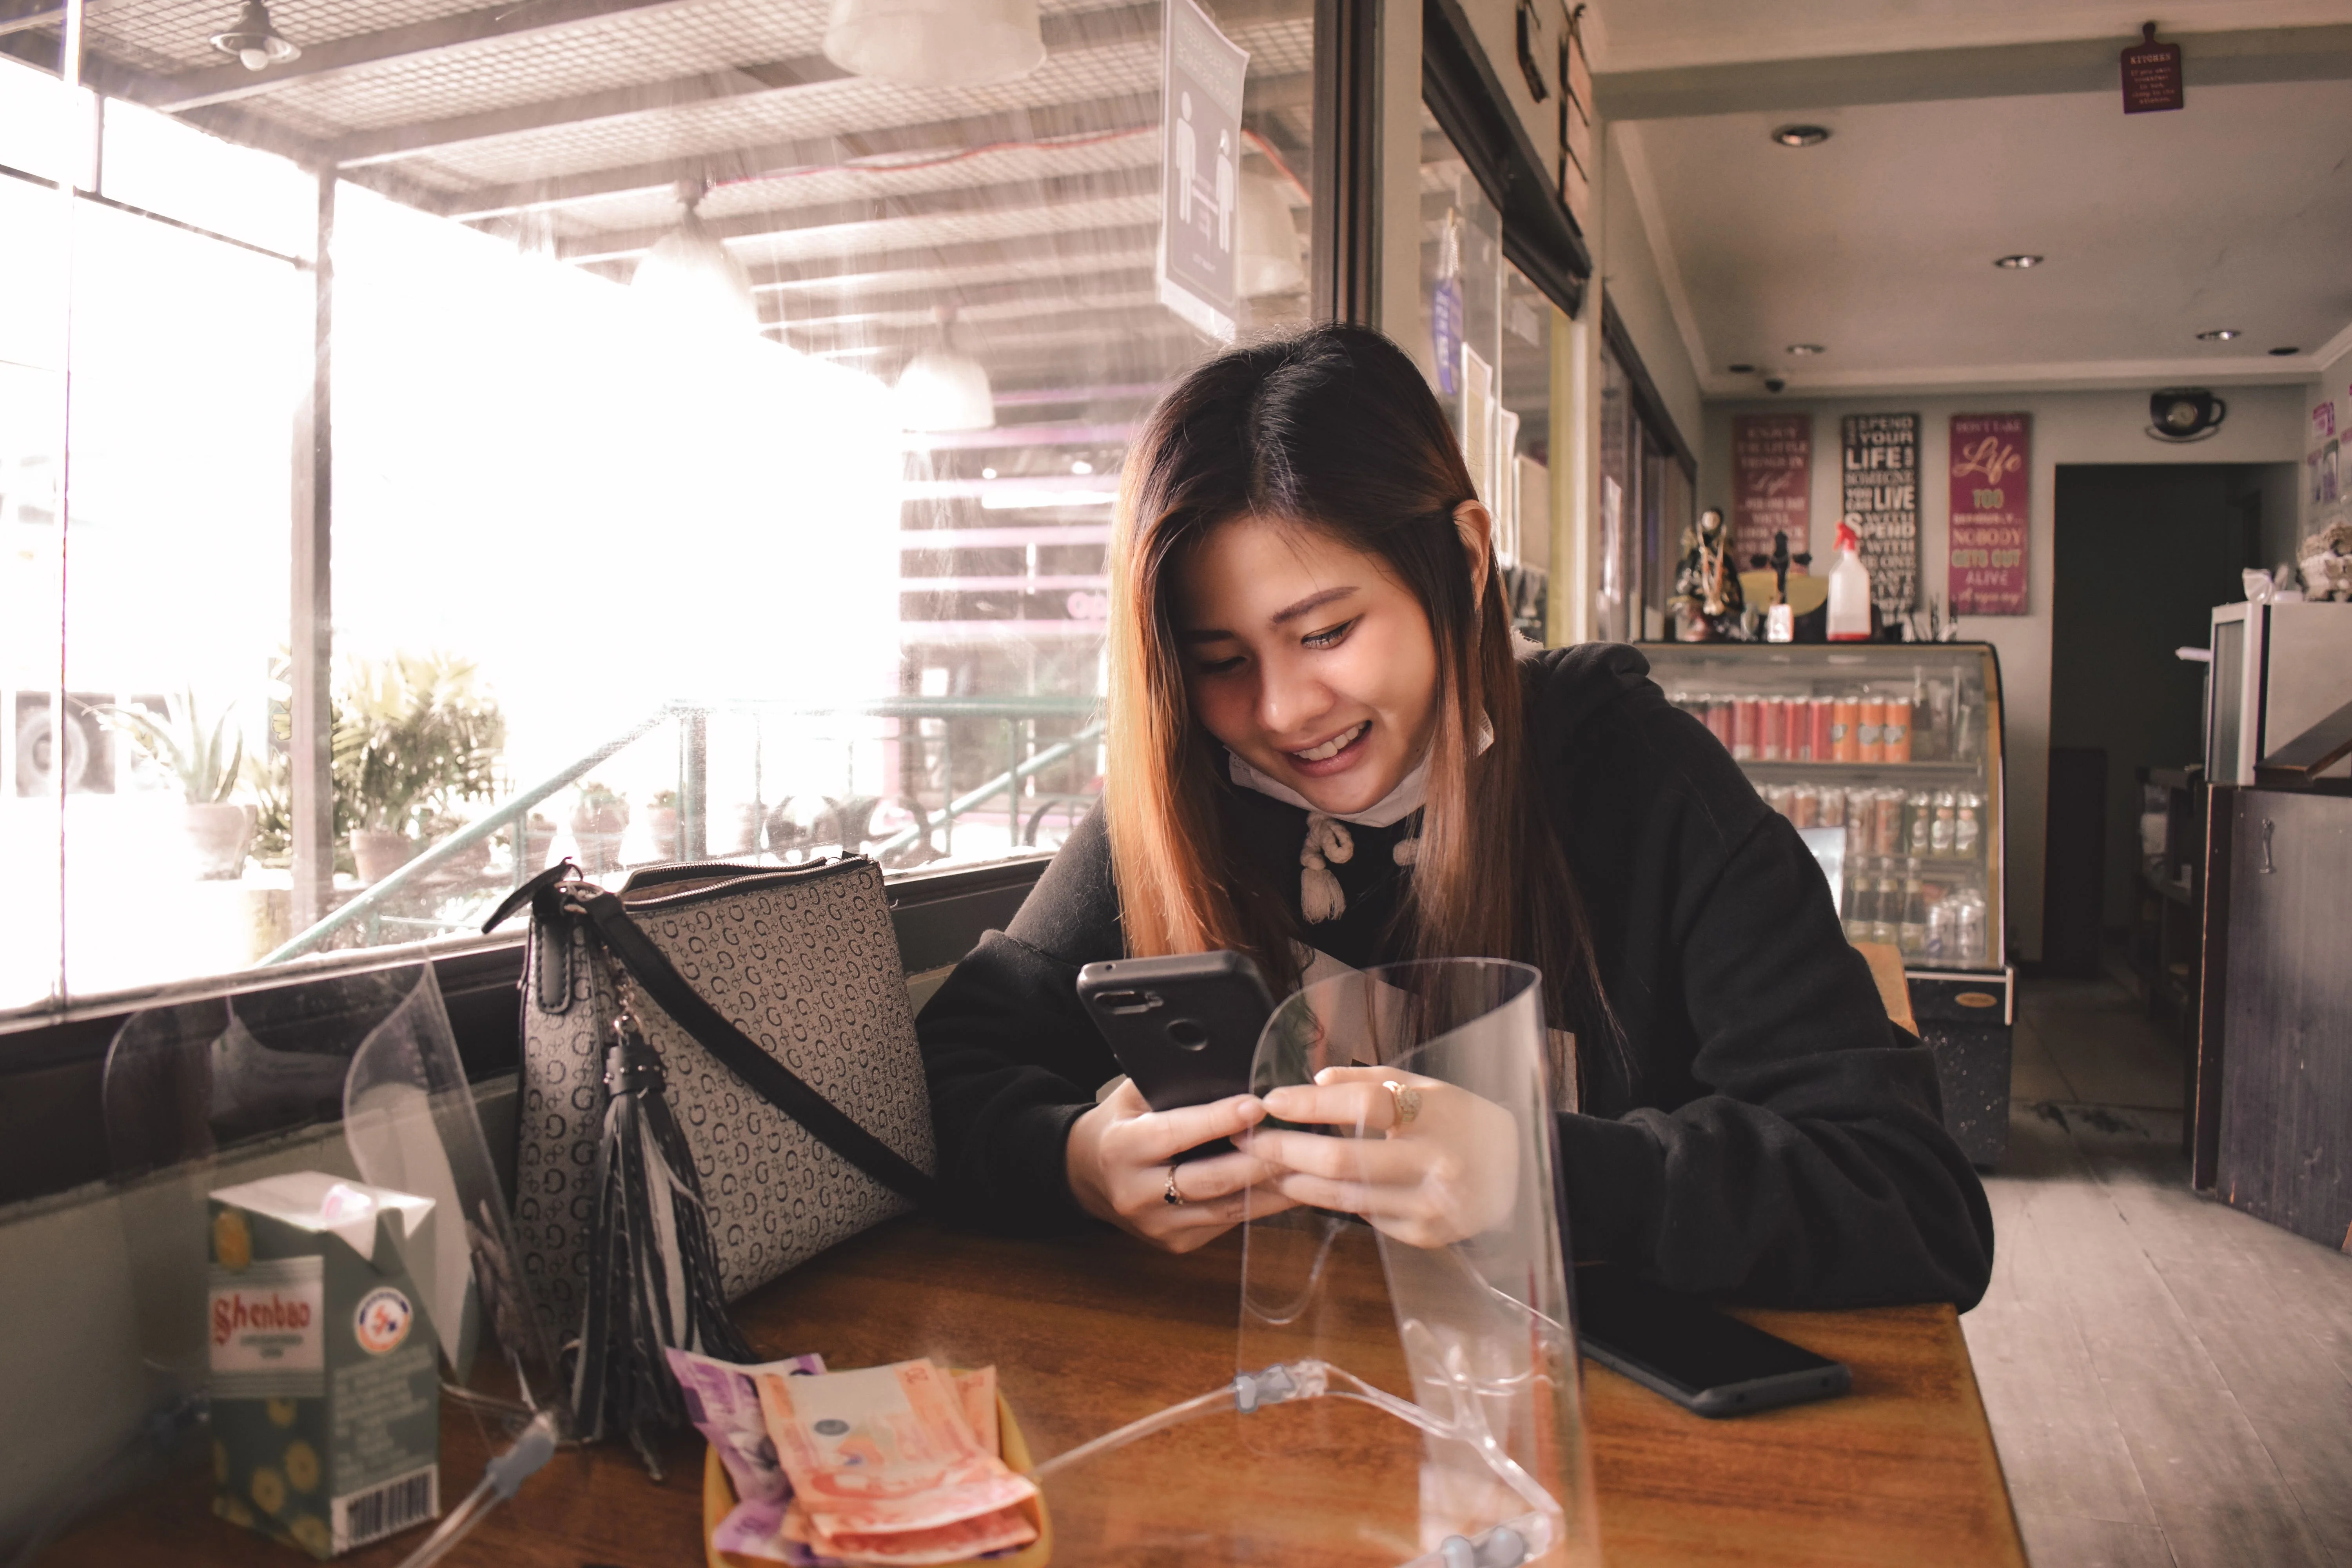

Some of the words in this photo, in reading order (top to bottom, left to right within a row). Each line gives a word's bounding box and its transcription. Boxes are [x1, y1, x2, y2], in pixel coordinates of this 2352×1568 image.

[2130, 53, 2171, 64] KITCHEN
[1859, 430, 1914, 445] YOUR
[1846, 446, 1902, 470] LIFE
[1952, 436, 2022, 485] Life
[1874, 486, 1915, 510] LIVE
[1973, 488, 2004, 508] TOO
[1844, 512, 1915, 539] SPEND
[1953, 528, 2022, 546] NOBODY
[1991, 549, 2022, 568] OUT
[1965, 570, 2009, 586] ALIVE
